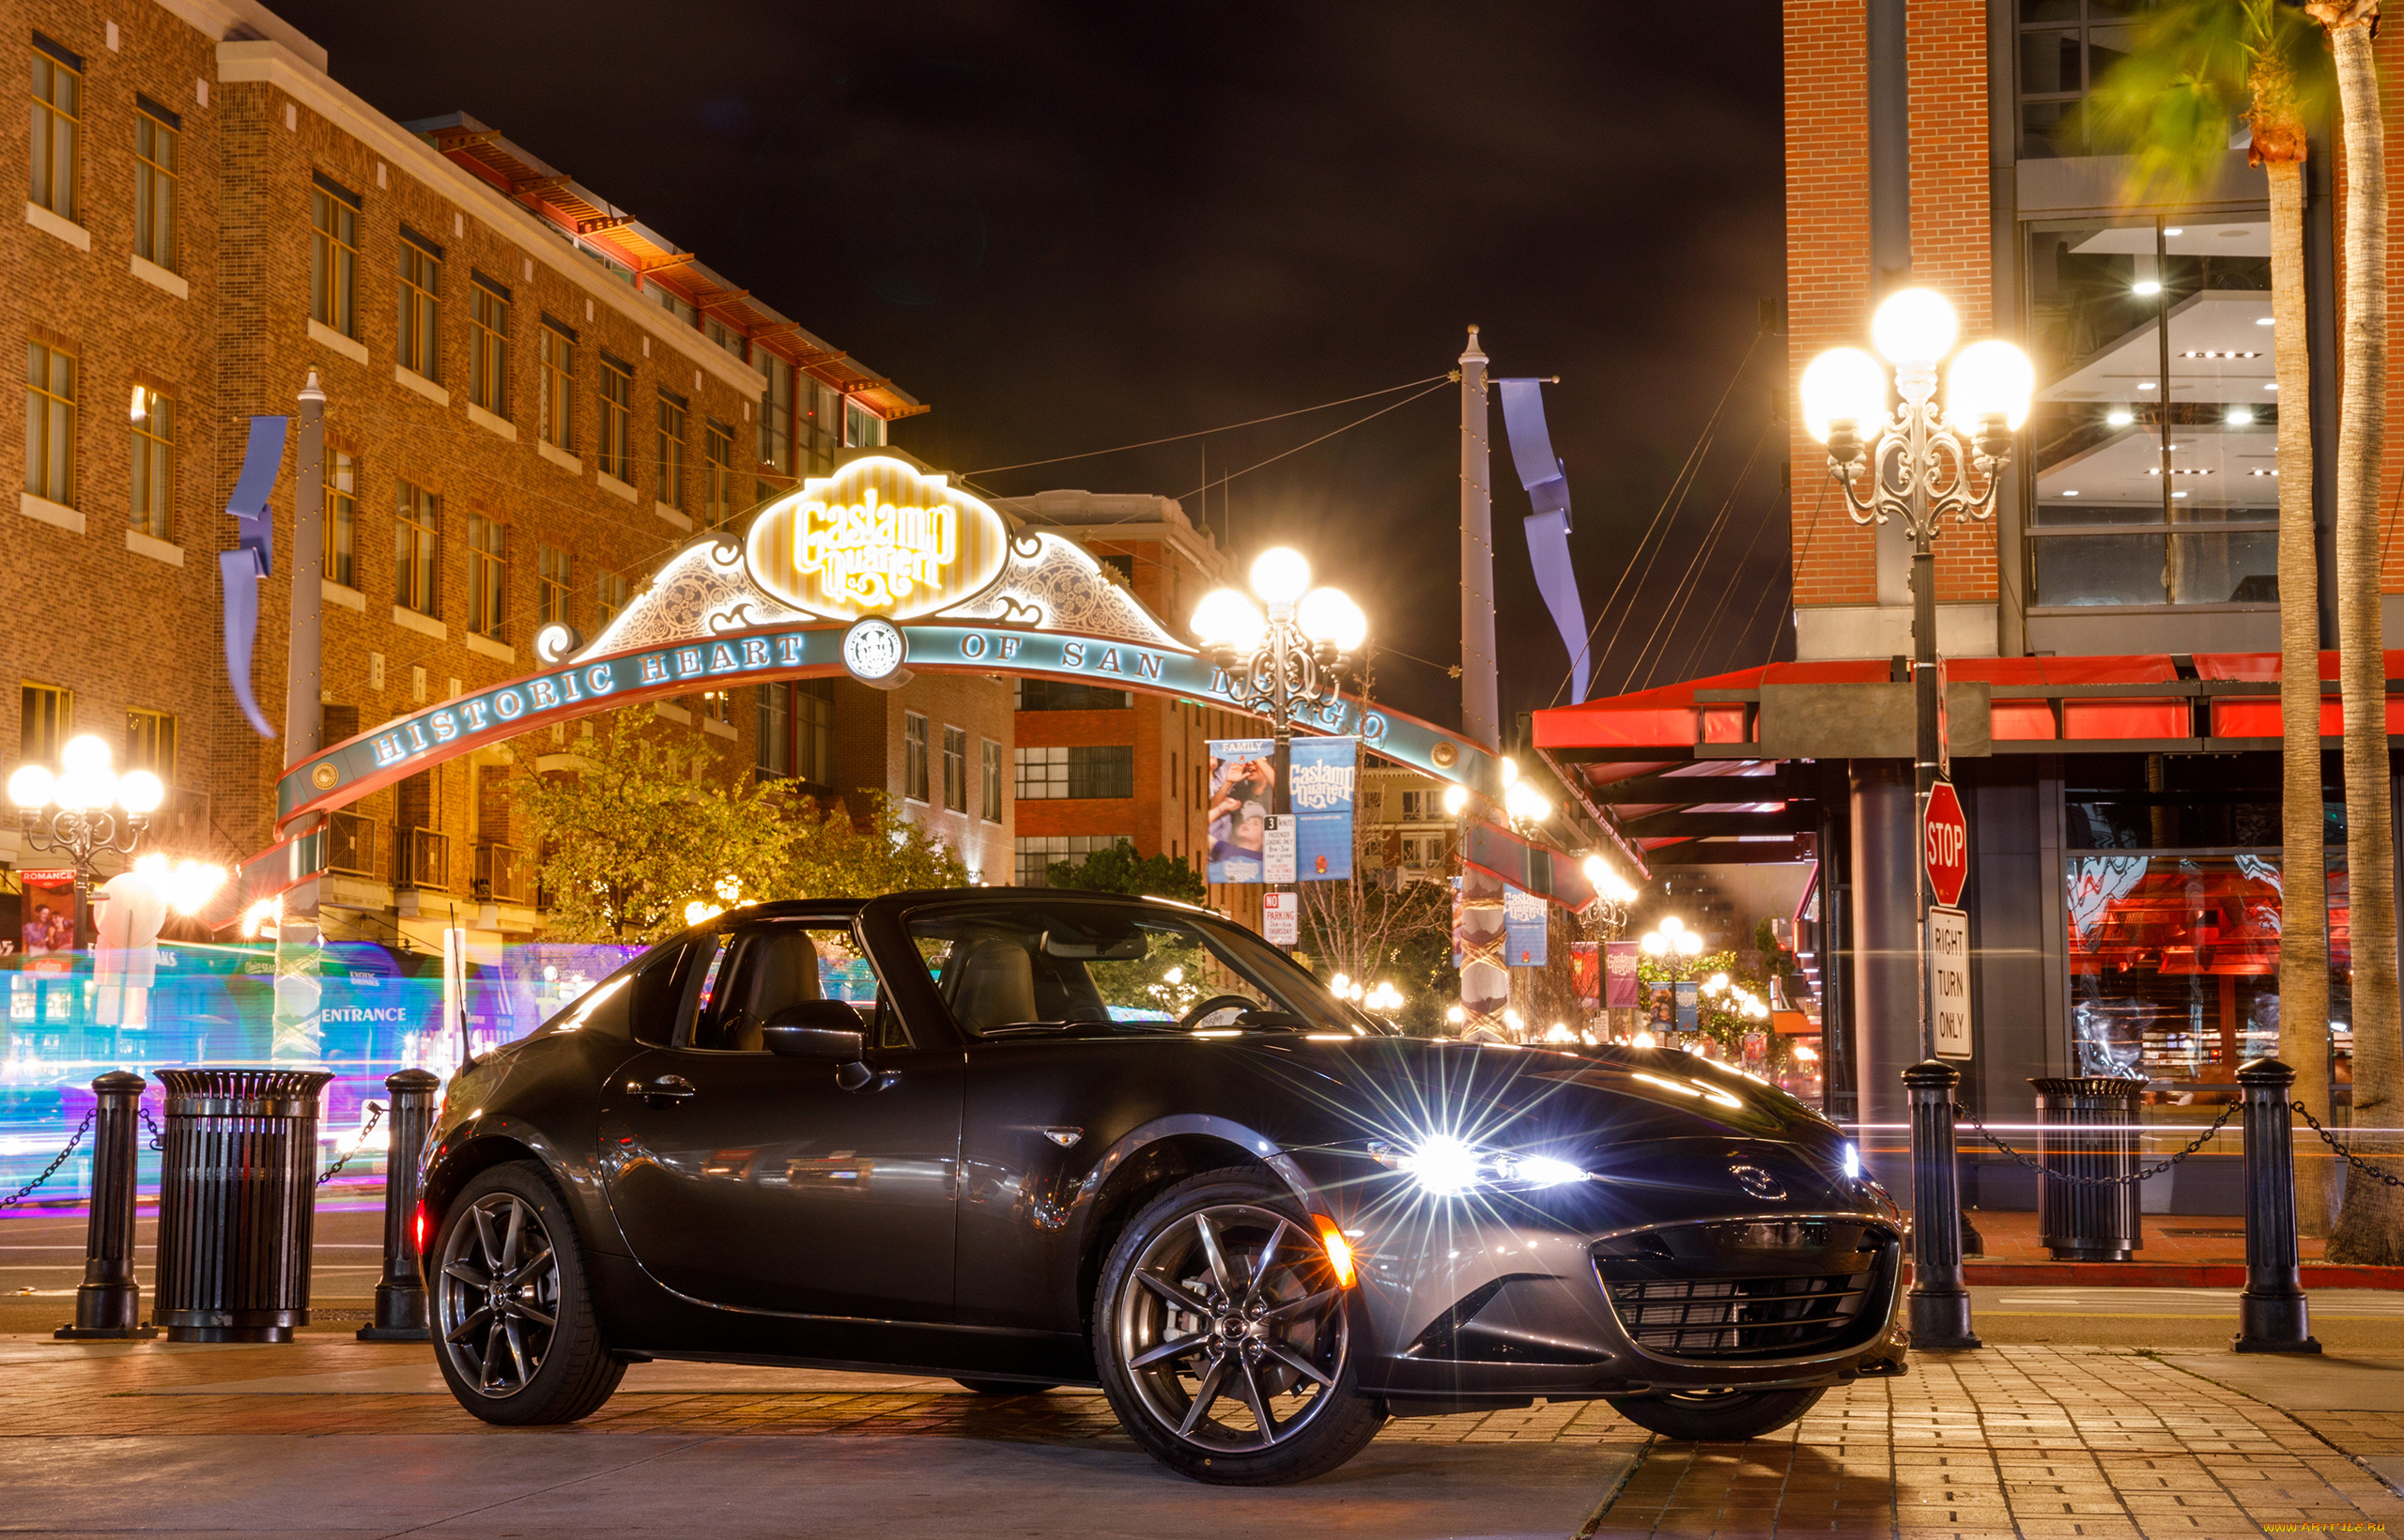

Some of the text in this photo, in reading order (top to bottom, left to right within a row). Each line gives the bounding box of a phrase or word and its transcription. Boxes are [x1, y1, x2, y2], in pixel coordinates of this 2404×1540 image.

[794, 488, 955, 573] Gaslamp
[821, 545, 943, 607] Quarter
[370, 665, 614, 765] HISTORIC
[638, 635, 802, 684] HEART
[961, 632, 1022, 661] OF
[1062, 642, 1165, 680] SAN
[1208, 668, 1385, 739] DGO
[1222, 741, 1263, 752] FAMILY
[1289, 758, 1355, 796] Gaslamp
[1297, 784, 1352, 809] Quarter
[1268, 817, 1274, 829] 3
[1927, 821, 1964, 868] STOP
[23, 871, 74, 881] ROMANCE
[1266, 895, 1277, 907] NO
[1267, 911, 1295, 920] PARKING
[1934, 927, 1963, 957] RIGHT
[349, 971, 377, 979] EXOTIC
[350, 978, 380, 987] DRINKS
[1937, 969, 1964, 997] TURN
[321, 1008, 407, 1024] ENTRANCE
[1939, 1011, 1965, 1039] ONLY
